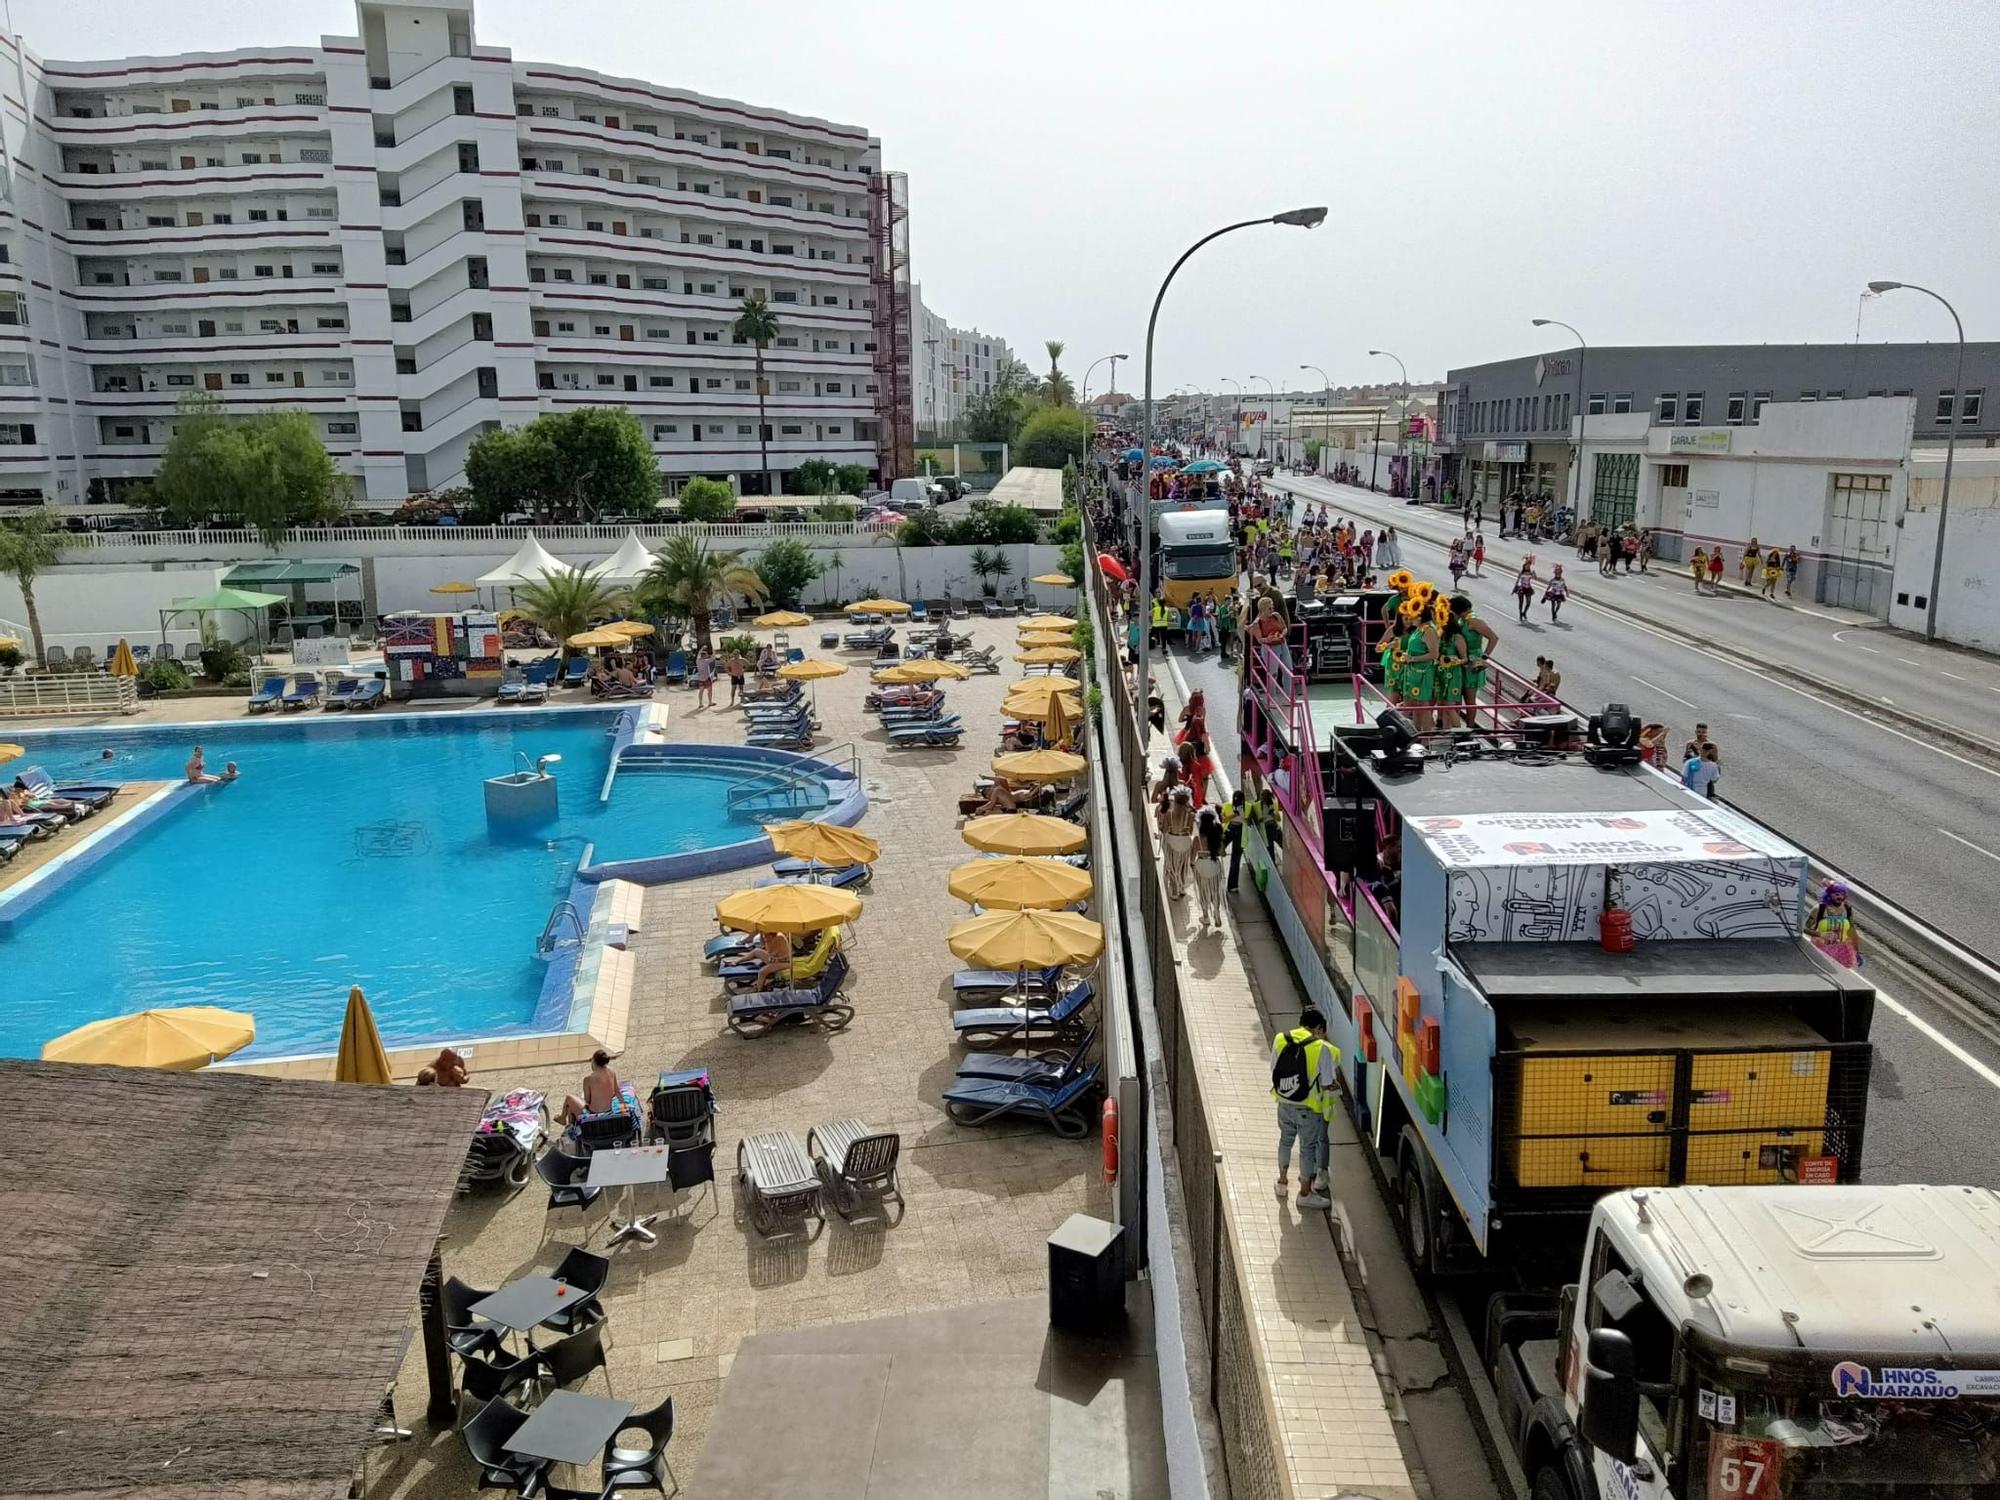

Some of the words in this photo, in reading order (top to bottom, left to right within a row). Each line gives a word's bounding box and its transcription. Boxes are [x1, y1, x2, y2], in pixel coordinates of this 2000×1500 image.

[1279, 1074, 1301, 1091] NIKE
[1884, 1370, 1942, 1384] HNOS.
[1870, 1385, 1959, 1398] NARANJO
[1720, 1457, 1765, 1495] 57
